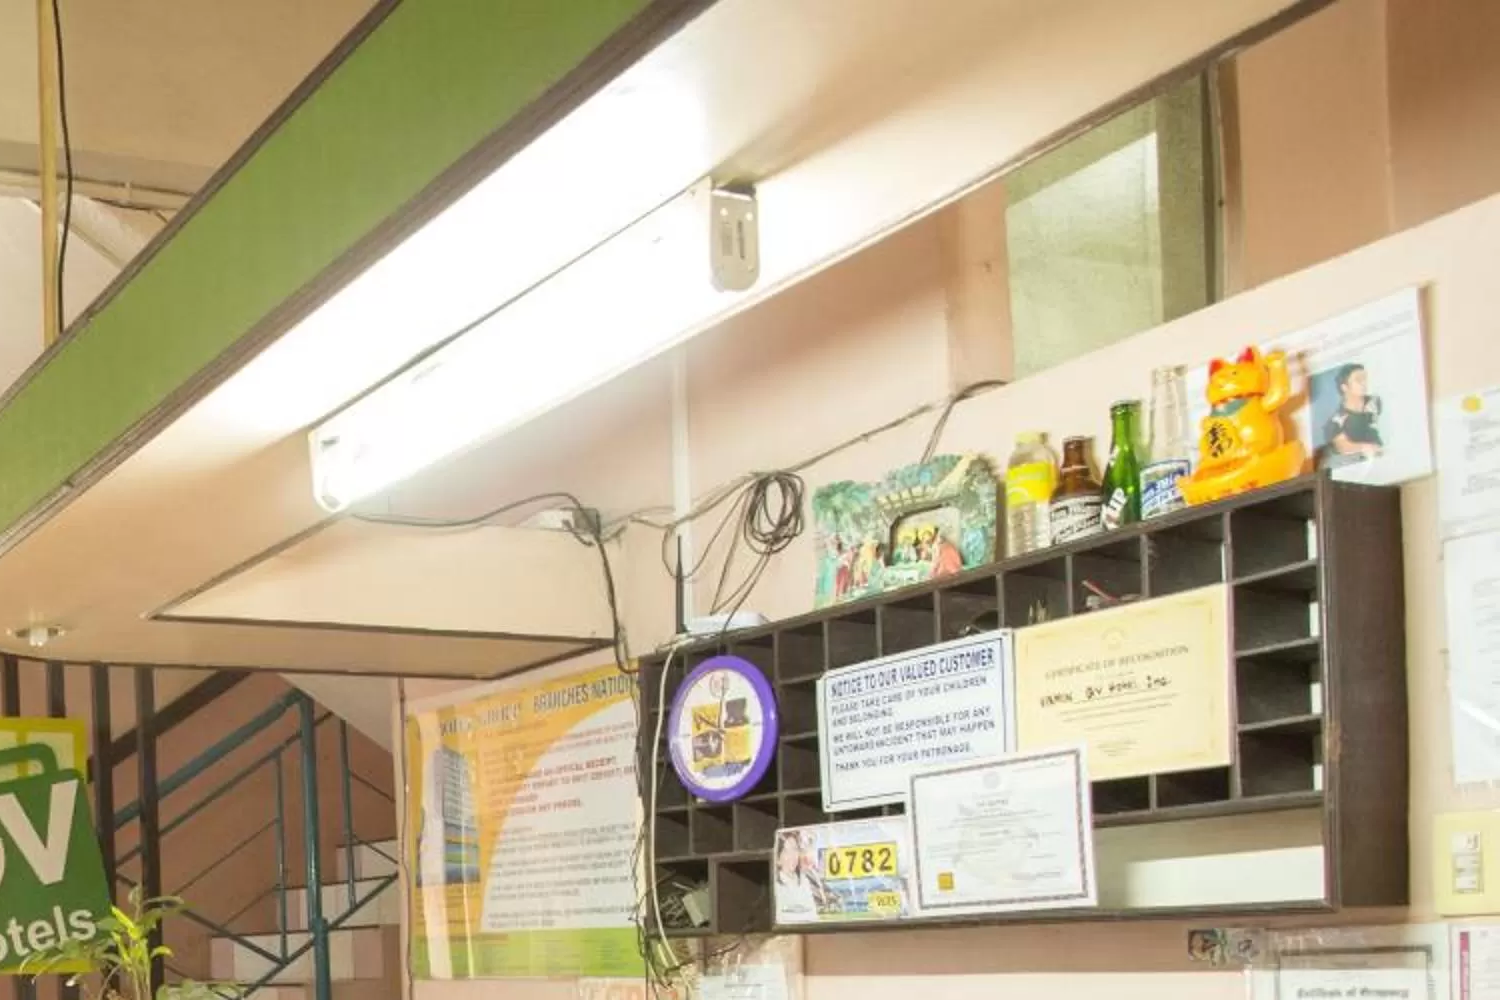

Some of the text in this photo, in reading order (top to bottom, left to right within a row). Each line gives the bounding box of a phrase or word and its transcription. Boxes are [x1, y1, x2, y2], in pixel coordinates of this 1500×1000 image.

[831, 647, 994, 698] NOTICE TO OUR VALUED CUSTOMER
[828, 847, 893, 876] 0782
